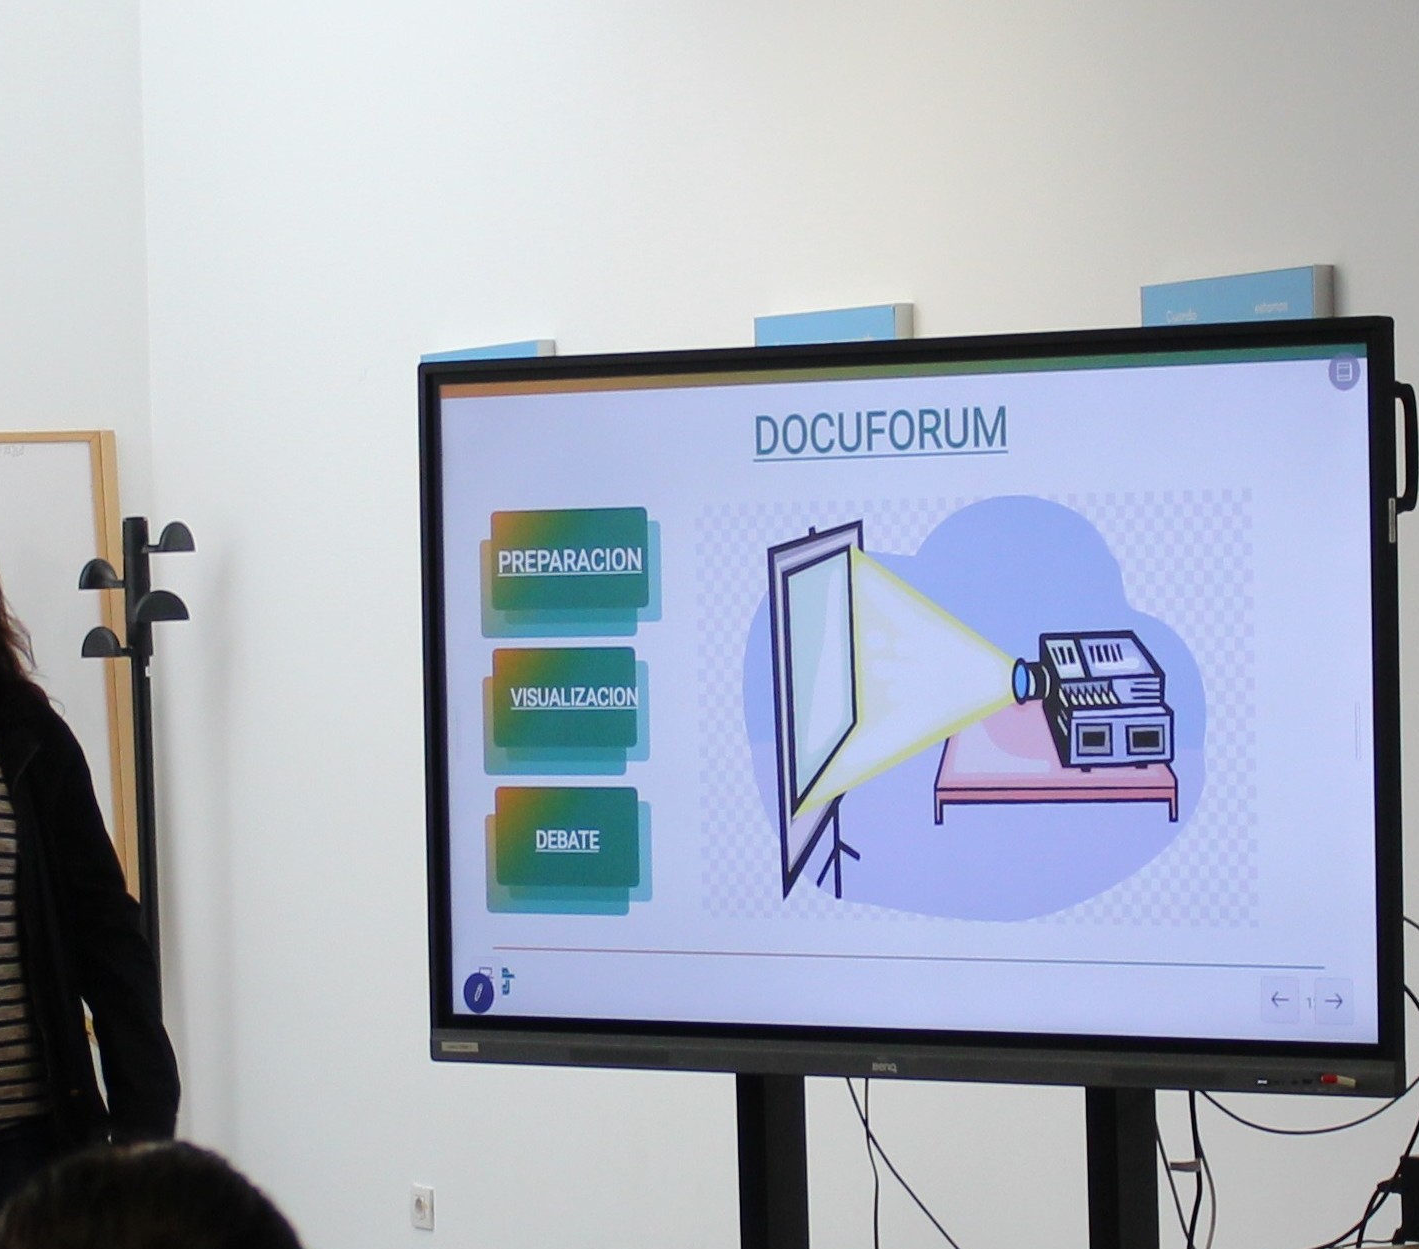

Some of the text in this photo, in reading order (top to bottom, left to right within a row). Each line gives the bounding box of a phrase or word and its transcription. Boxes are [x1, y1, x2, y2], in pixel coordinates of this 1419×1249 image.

[754, 405, 1009, 457] DOCUFORUM
[498, 547, 643, 574] PREPARACION
[510, 686, 639, 708] VISUALIZACION
[535, 829, 600, 851] DEBATE
